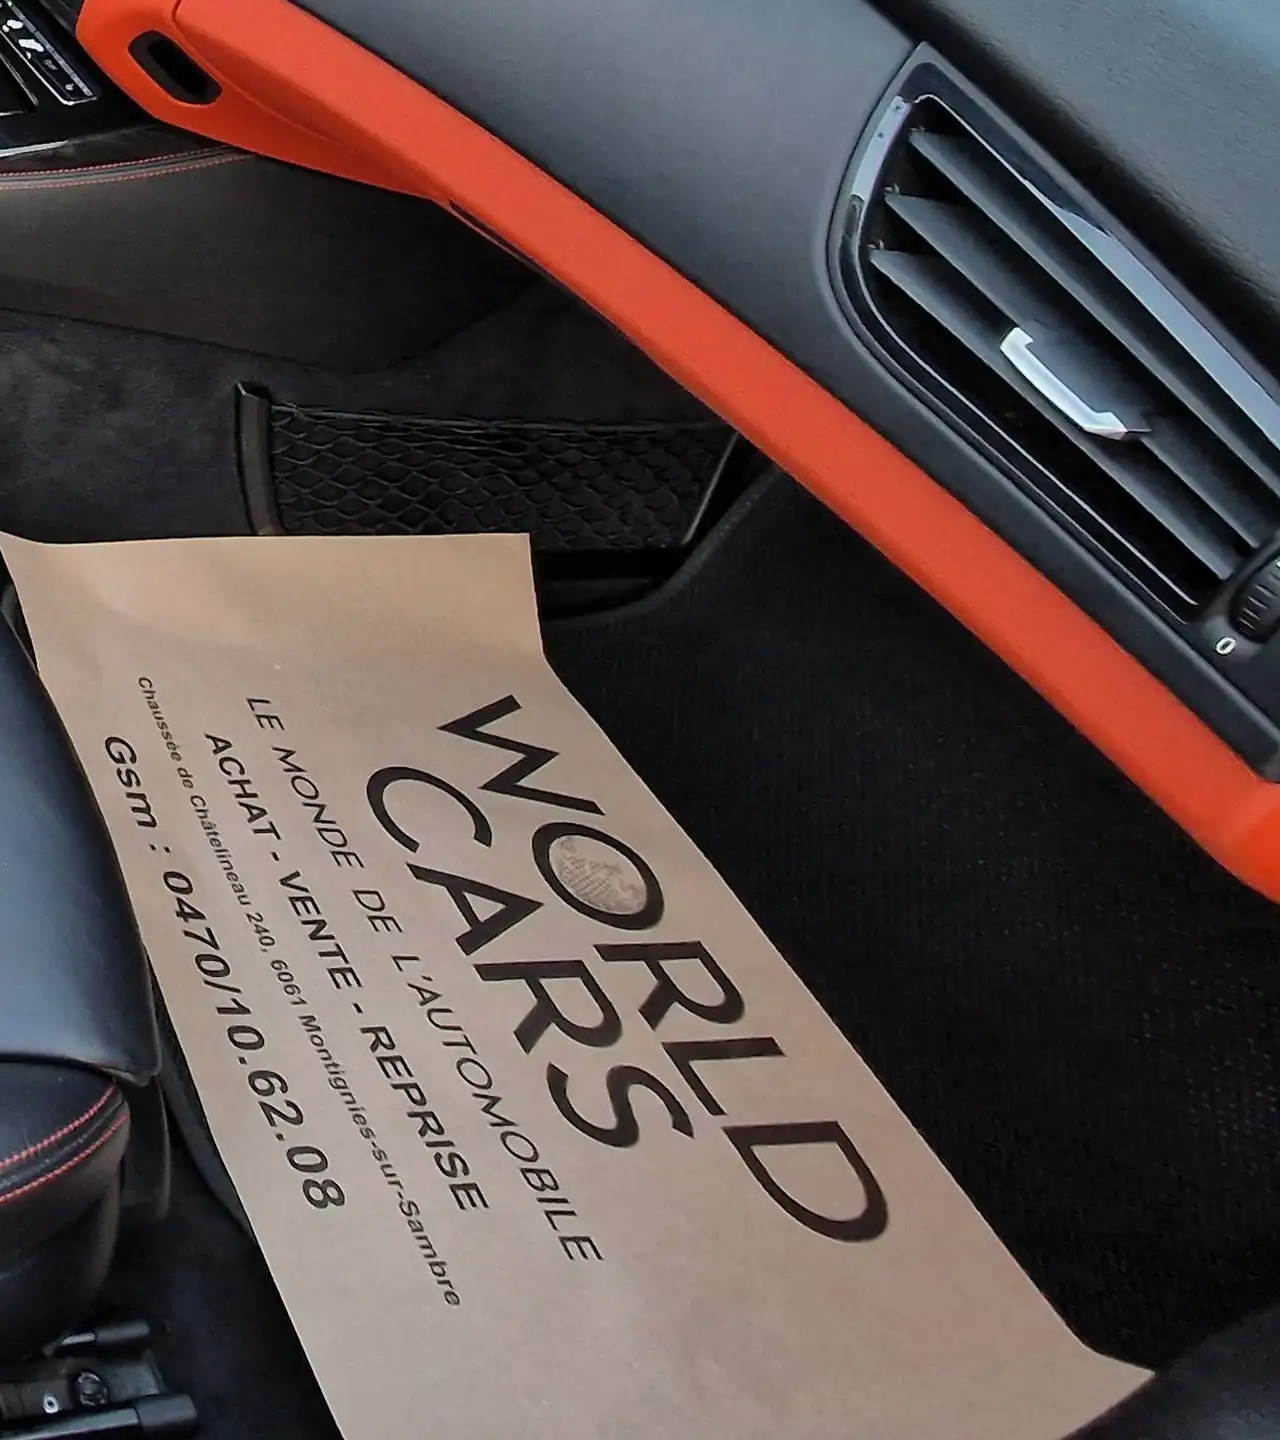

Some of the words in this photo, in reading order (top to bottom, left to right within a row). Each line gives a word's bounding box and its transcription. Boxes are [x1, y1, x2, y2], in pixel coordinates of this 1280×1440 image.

[104, 735, 159, 829] Gsm
[162, 870, 346, 1210] 0470/10.62.08
[138, 676, 183, 762] Chaussée
[176, 765, 194, 790] de
[189, 794, 253, 907] Châtelineau
[245, 911, 277, 953] 240,
[269, 958, 308, 1007] 6061
[297, 1013, 461, 1308] Montignies-sur-Sambre
[204, 733, 281, 841] ACHAT
[278, 869, 364, 990] VENTE
[359, 1024, 490, 1212] REPRISE
[245, 697, 285, 731] LE
[271, 746, 365, 869] MONDE
[351, 888, 404, 934] DE
[390, 954, 605, 1262] L'AUTOMOBILE
[366, 766, 695, 1149] CARS
[436, 693, 889, 1243] WORLD
